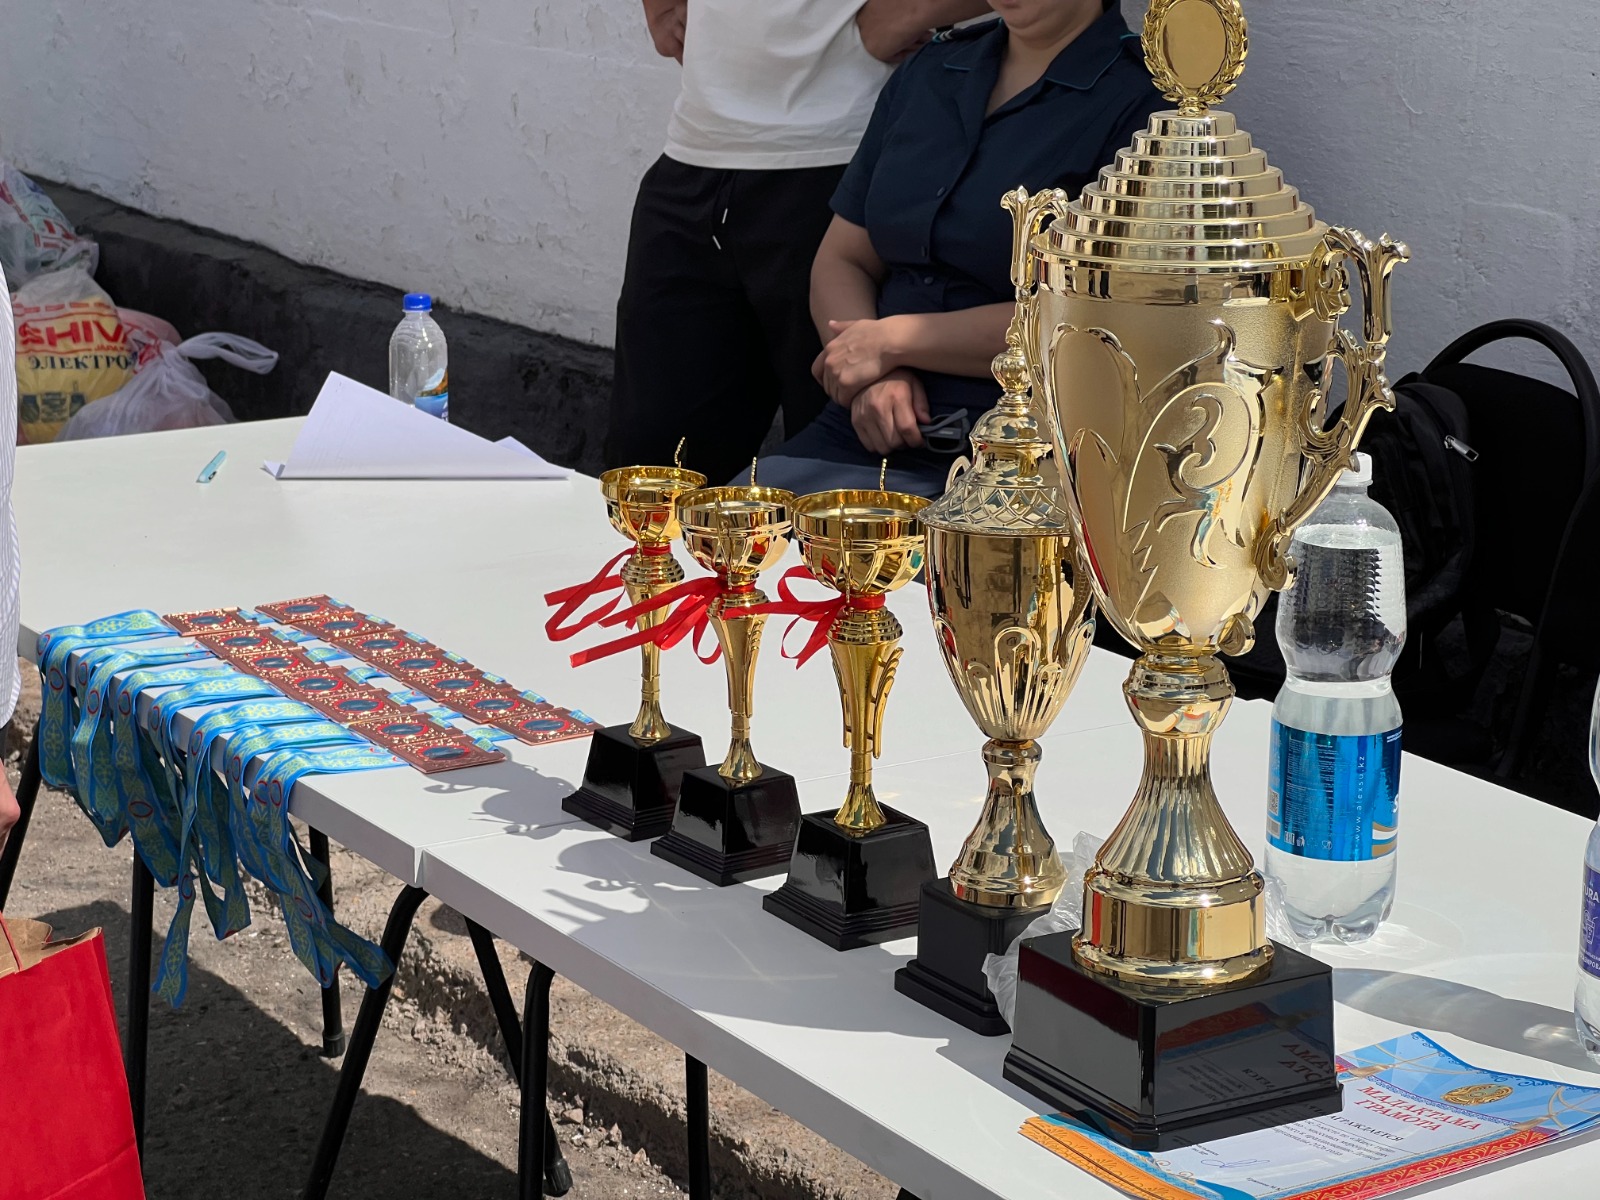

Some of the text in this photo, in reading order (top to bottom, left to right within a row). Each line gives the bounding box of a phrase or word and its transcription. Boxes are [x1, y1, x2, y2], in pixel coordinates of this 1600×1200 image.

[18, 319, 129, 347] SHIV
[1329, 1114, 1405, 1143] АГРАЖДАЕТСЯ
[1353, 1098, 1443, 1132] ГРАМОТА
